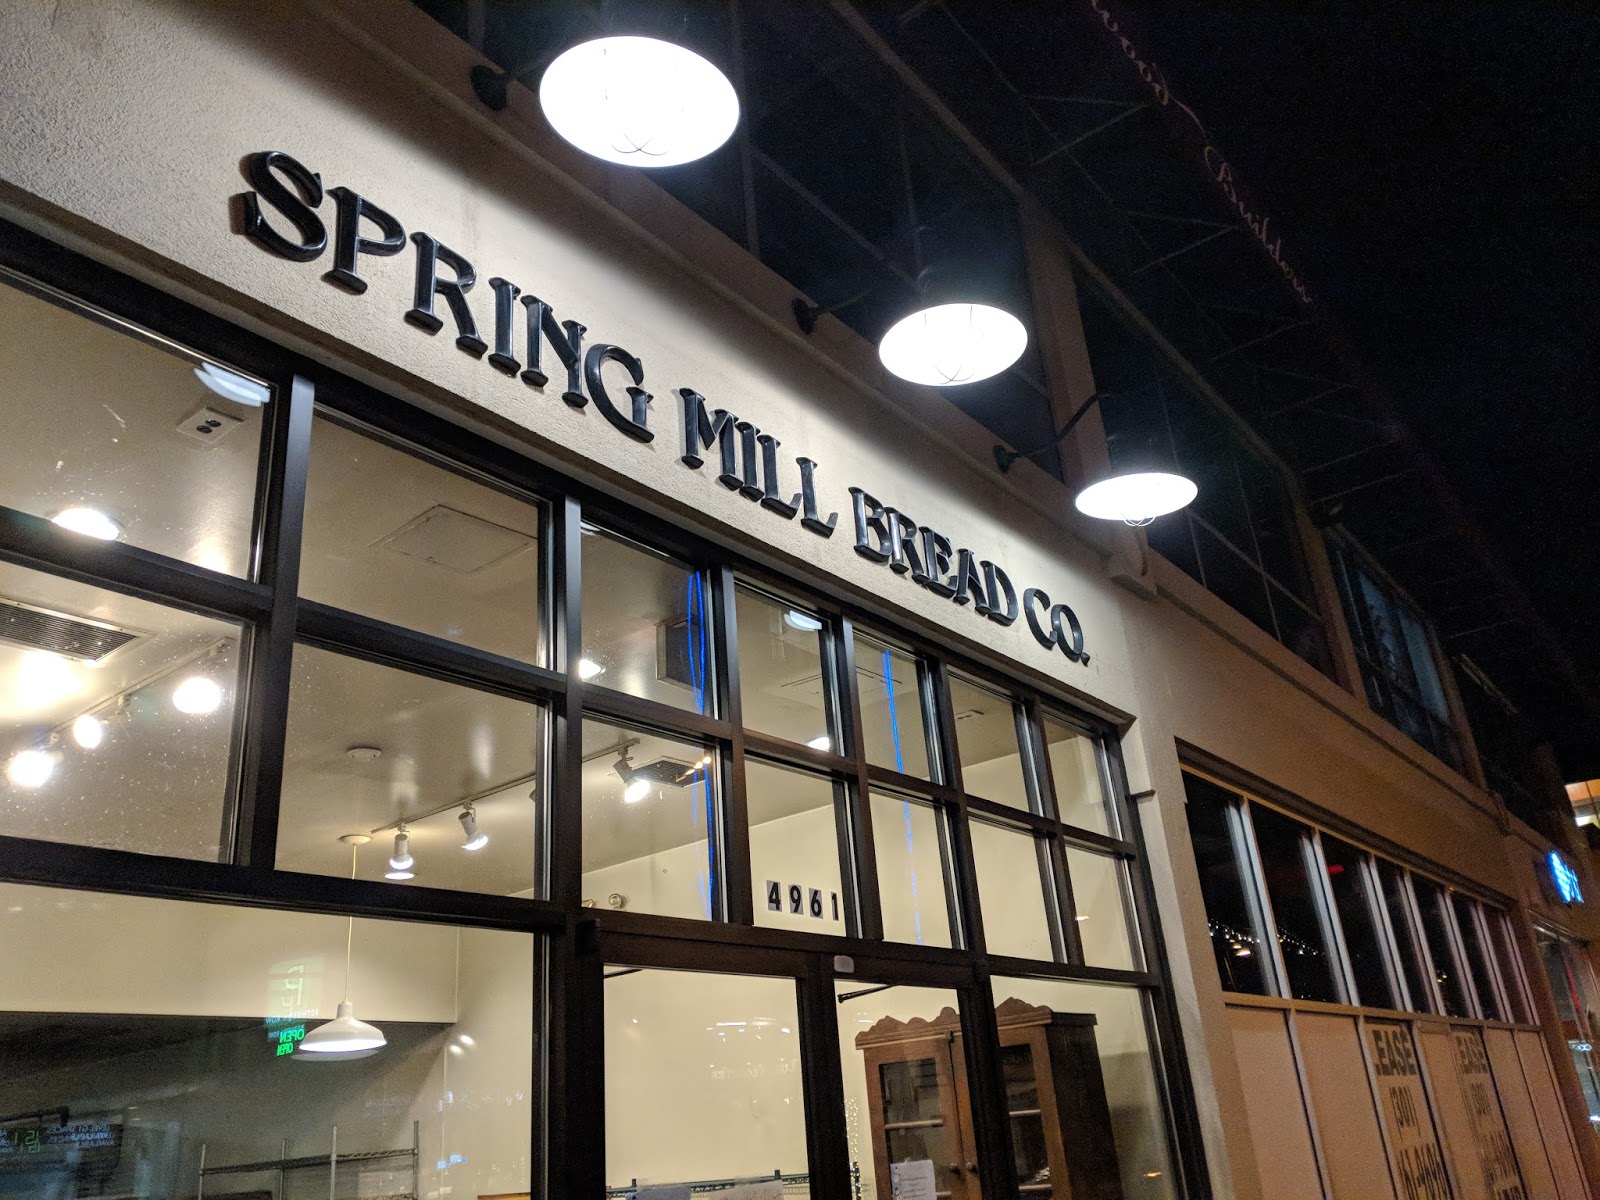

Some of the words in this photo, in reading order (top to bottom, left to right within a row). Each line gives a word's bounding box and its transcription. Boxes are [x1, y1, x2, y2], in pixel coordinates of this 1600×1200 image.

[242, 151, 654, 443] SPRING
[679, 388, 838, 538] MILL
[848, 486, 1019, 627] BREAD
[768, 882, 839, 921] 4961
